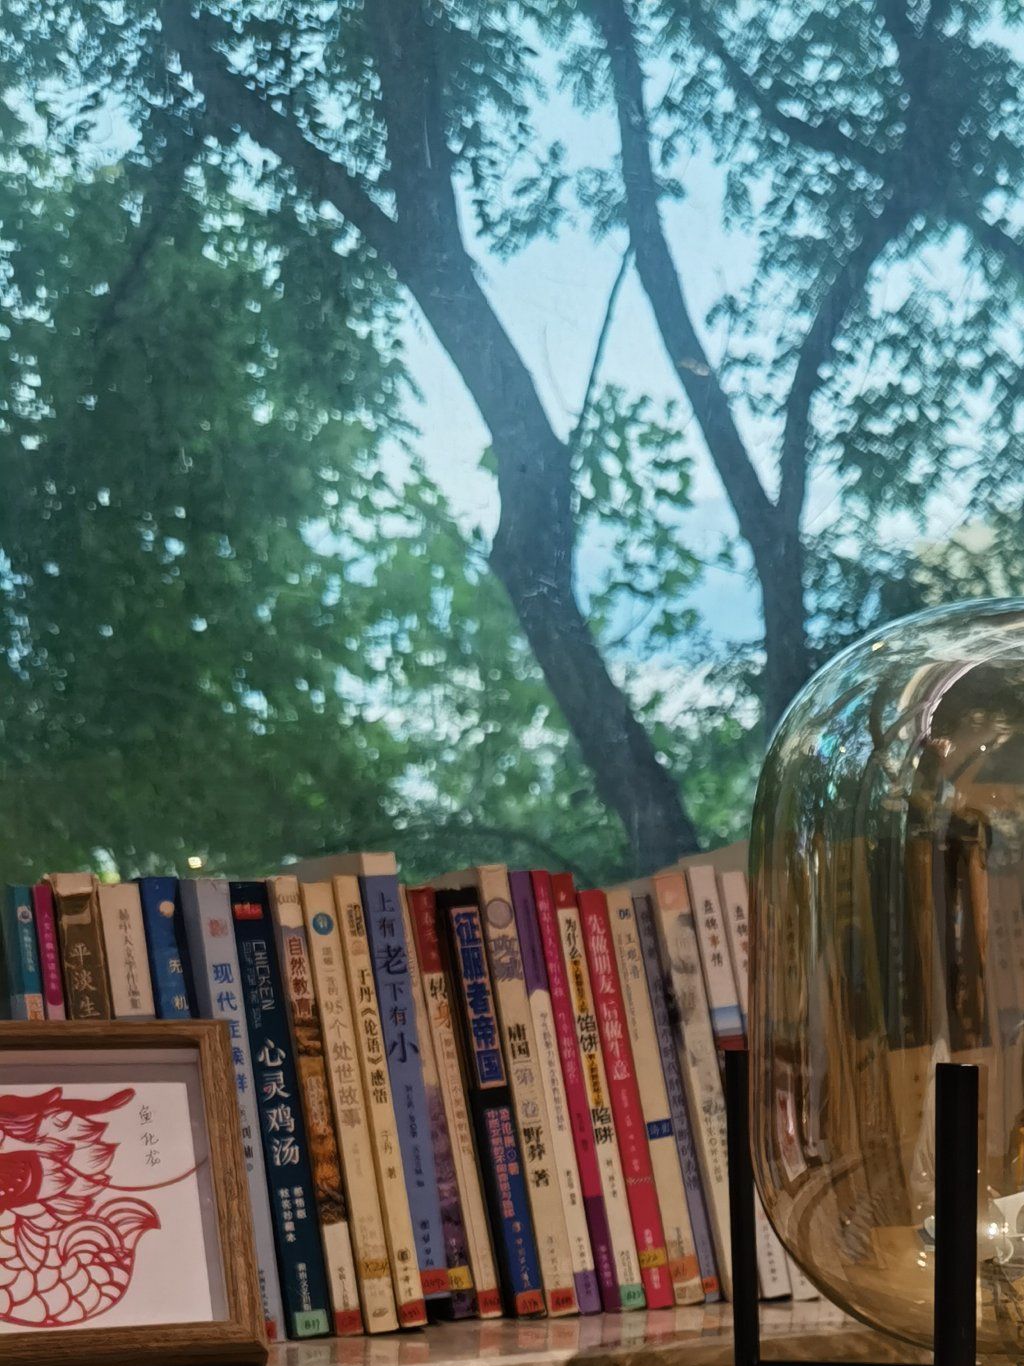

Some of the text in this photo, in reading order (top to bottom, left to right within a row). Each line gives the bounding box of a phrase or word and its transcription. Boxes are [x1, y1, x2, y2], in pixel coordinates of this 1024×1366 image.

[565, 917, 582, 960] 为什么
[703, 900, 724, 968] 盘锦事情
[251, 939, 276, 1012] CHICKEN
[289, 936, 313, 1019] 自然教育
[375, 892, 419, 1064] 上有老下有小
[454, 911, 505, 1083] 征服者帝国
[357, 968, 389, 1104] 于丹《论语》感悟
[577, 1015, 598, 1053] 馅饼
[258, 1037, 300, 1168] 心灵鸡汤
[591, 1107, 615, 1145] 陷阱
